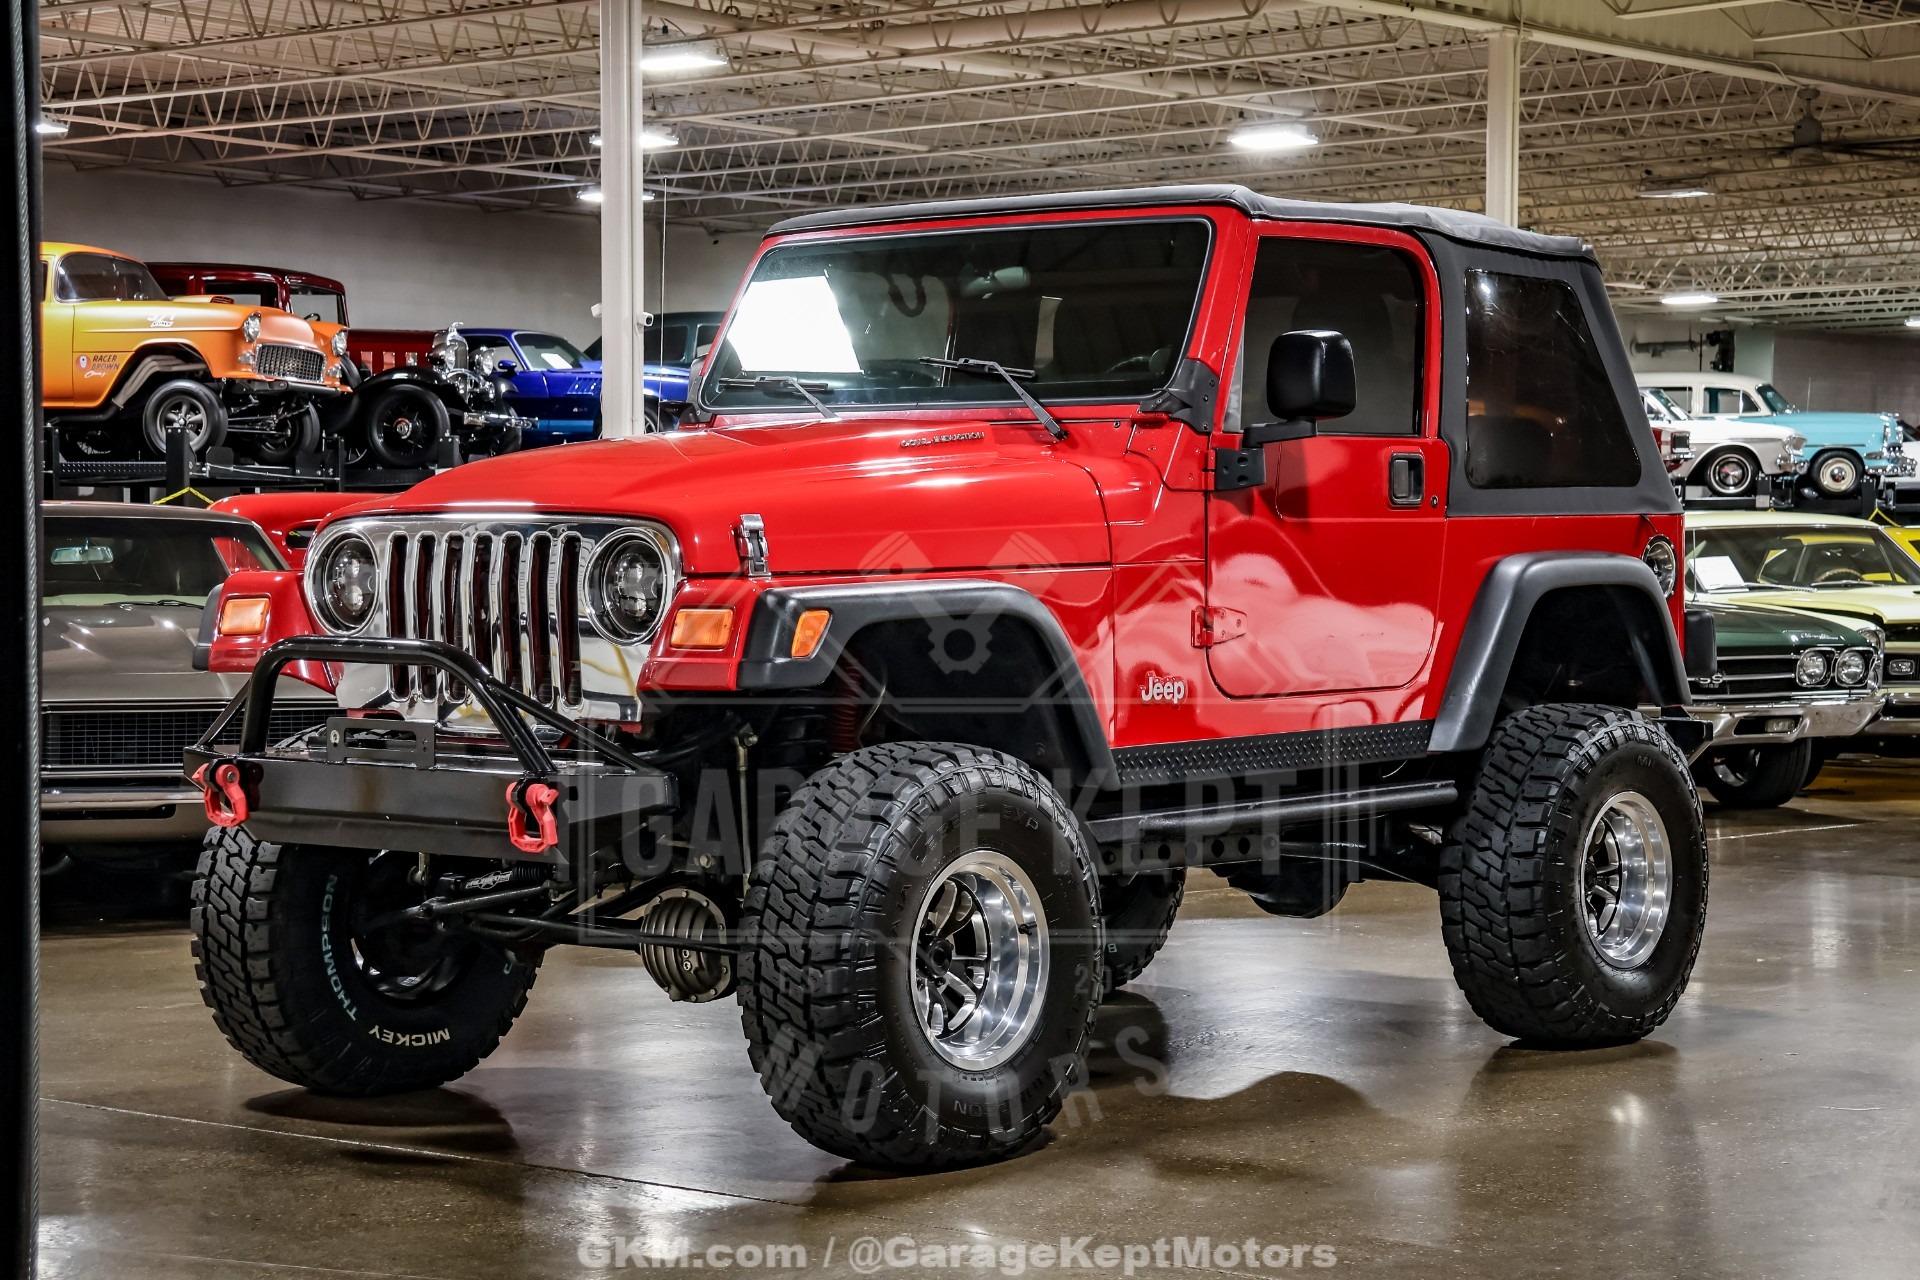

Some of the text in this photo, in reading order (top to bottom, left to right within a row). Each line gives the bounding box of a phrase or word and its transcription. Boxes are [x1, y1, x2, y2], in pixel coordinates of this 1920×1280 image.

[92, 354, 118, 362] RACER
[1141, 675, 1185, 704] Jeep
[320, 873, 359, 1022] THOMPSON
[367, 1024, 451, 1047] MICKEY
